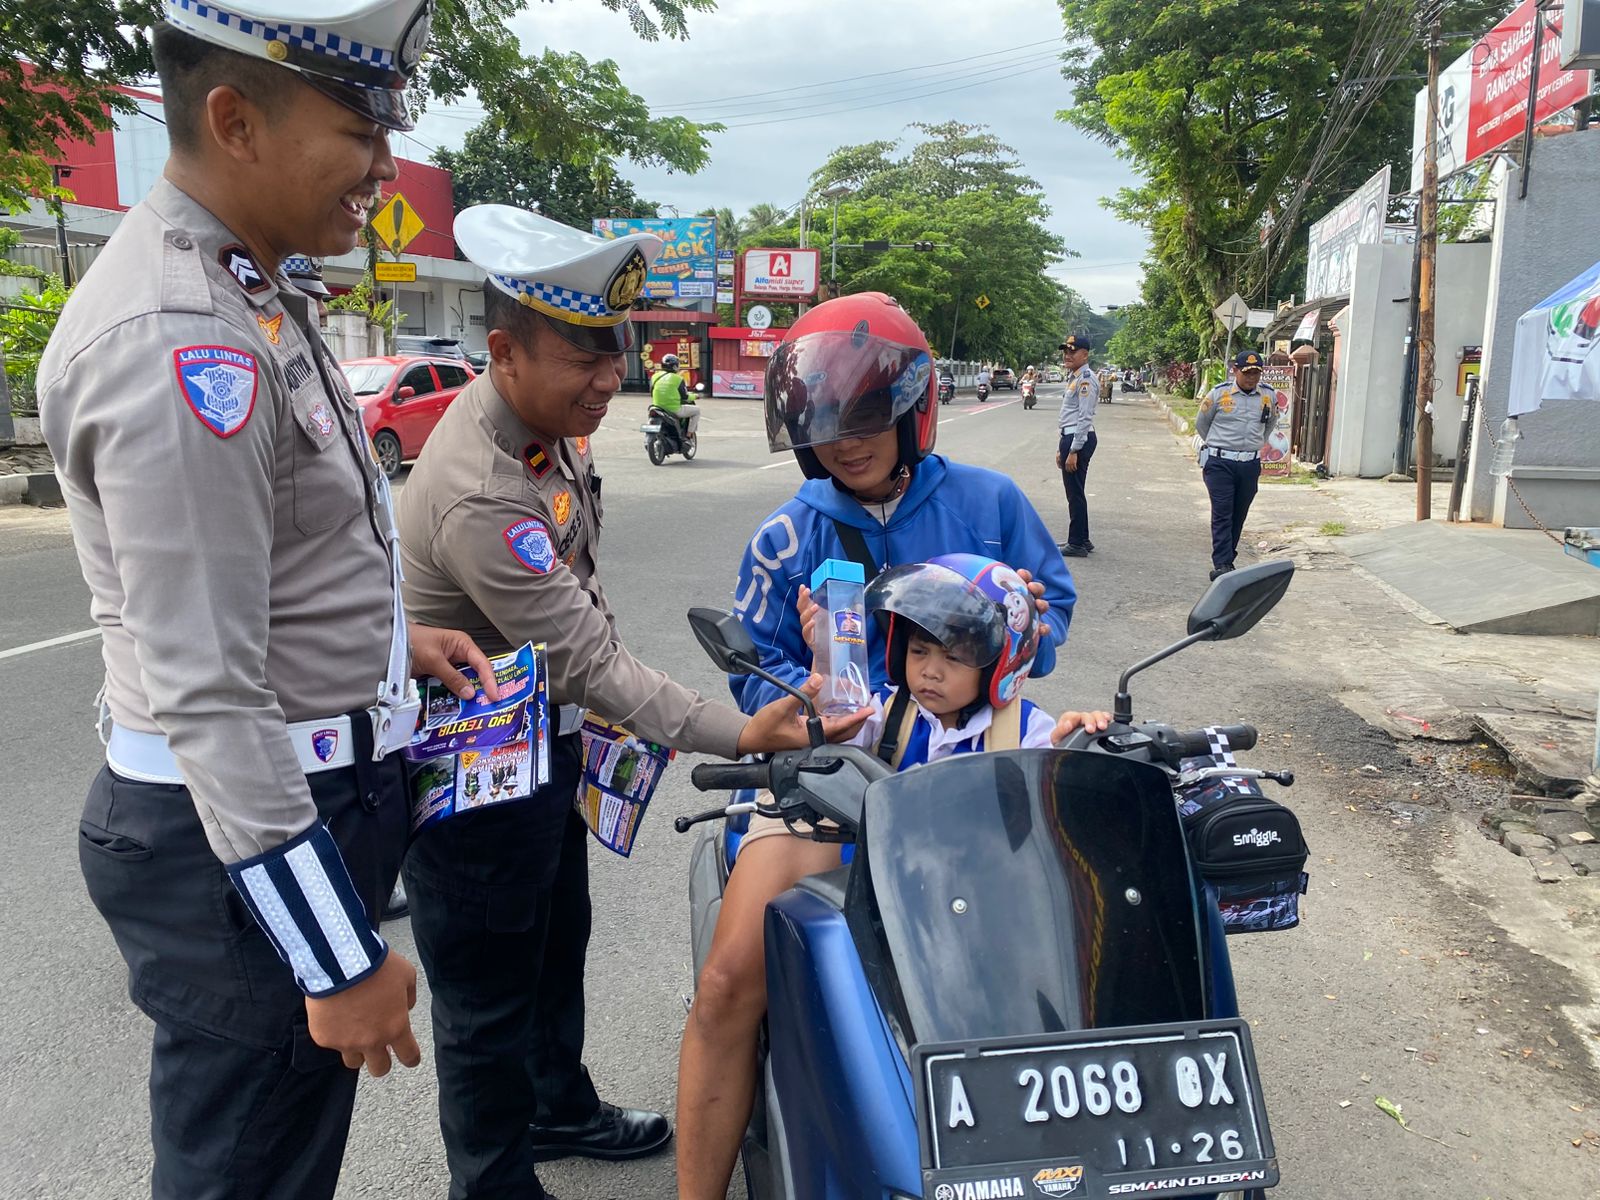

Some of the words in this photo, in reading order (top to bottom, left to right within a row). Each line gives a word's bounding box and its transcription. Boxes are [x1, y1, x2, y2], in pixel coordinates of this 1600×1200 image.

[179, 349, 210, 361] LALU
[214, 349, 253, 367] LINTAS
[507, 523, 526, 538] LALU
[438, 718, 484, 738] TERTIB
[487, 711, 516, 728] AYO
[949, 1075, 976, 1129] A
[1019, 1060, 1143, 1123] 2068
[1207, 1170, 1265, 1184] DEPAN
[953, 1177, 1025, 1200] YAMAHA
[1043, 1182, 1072, 1193] YAMAHA
